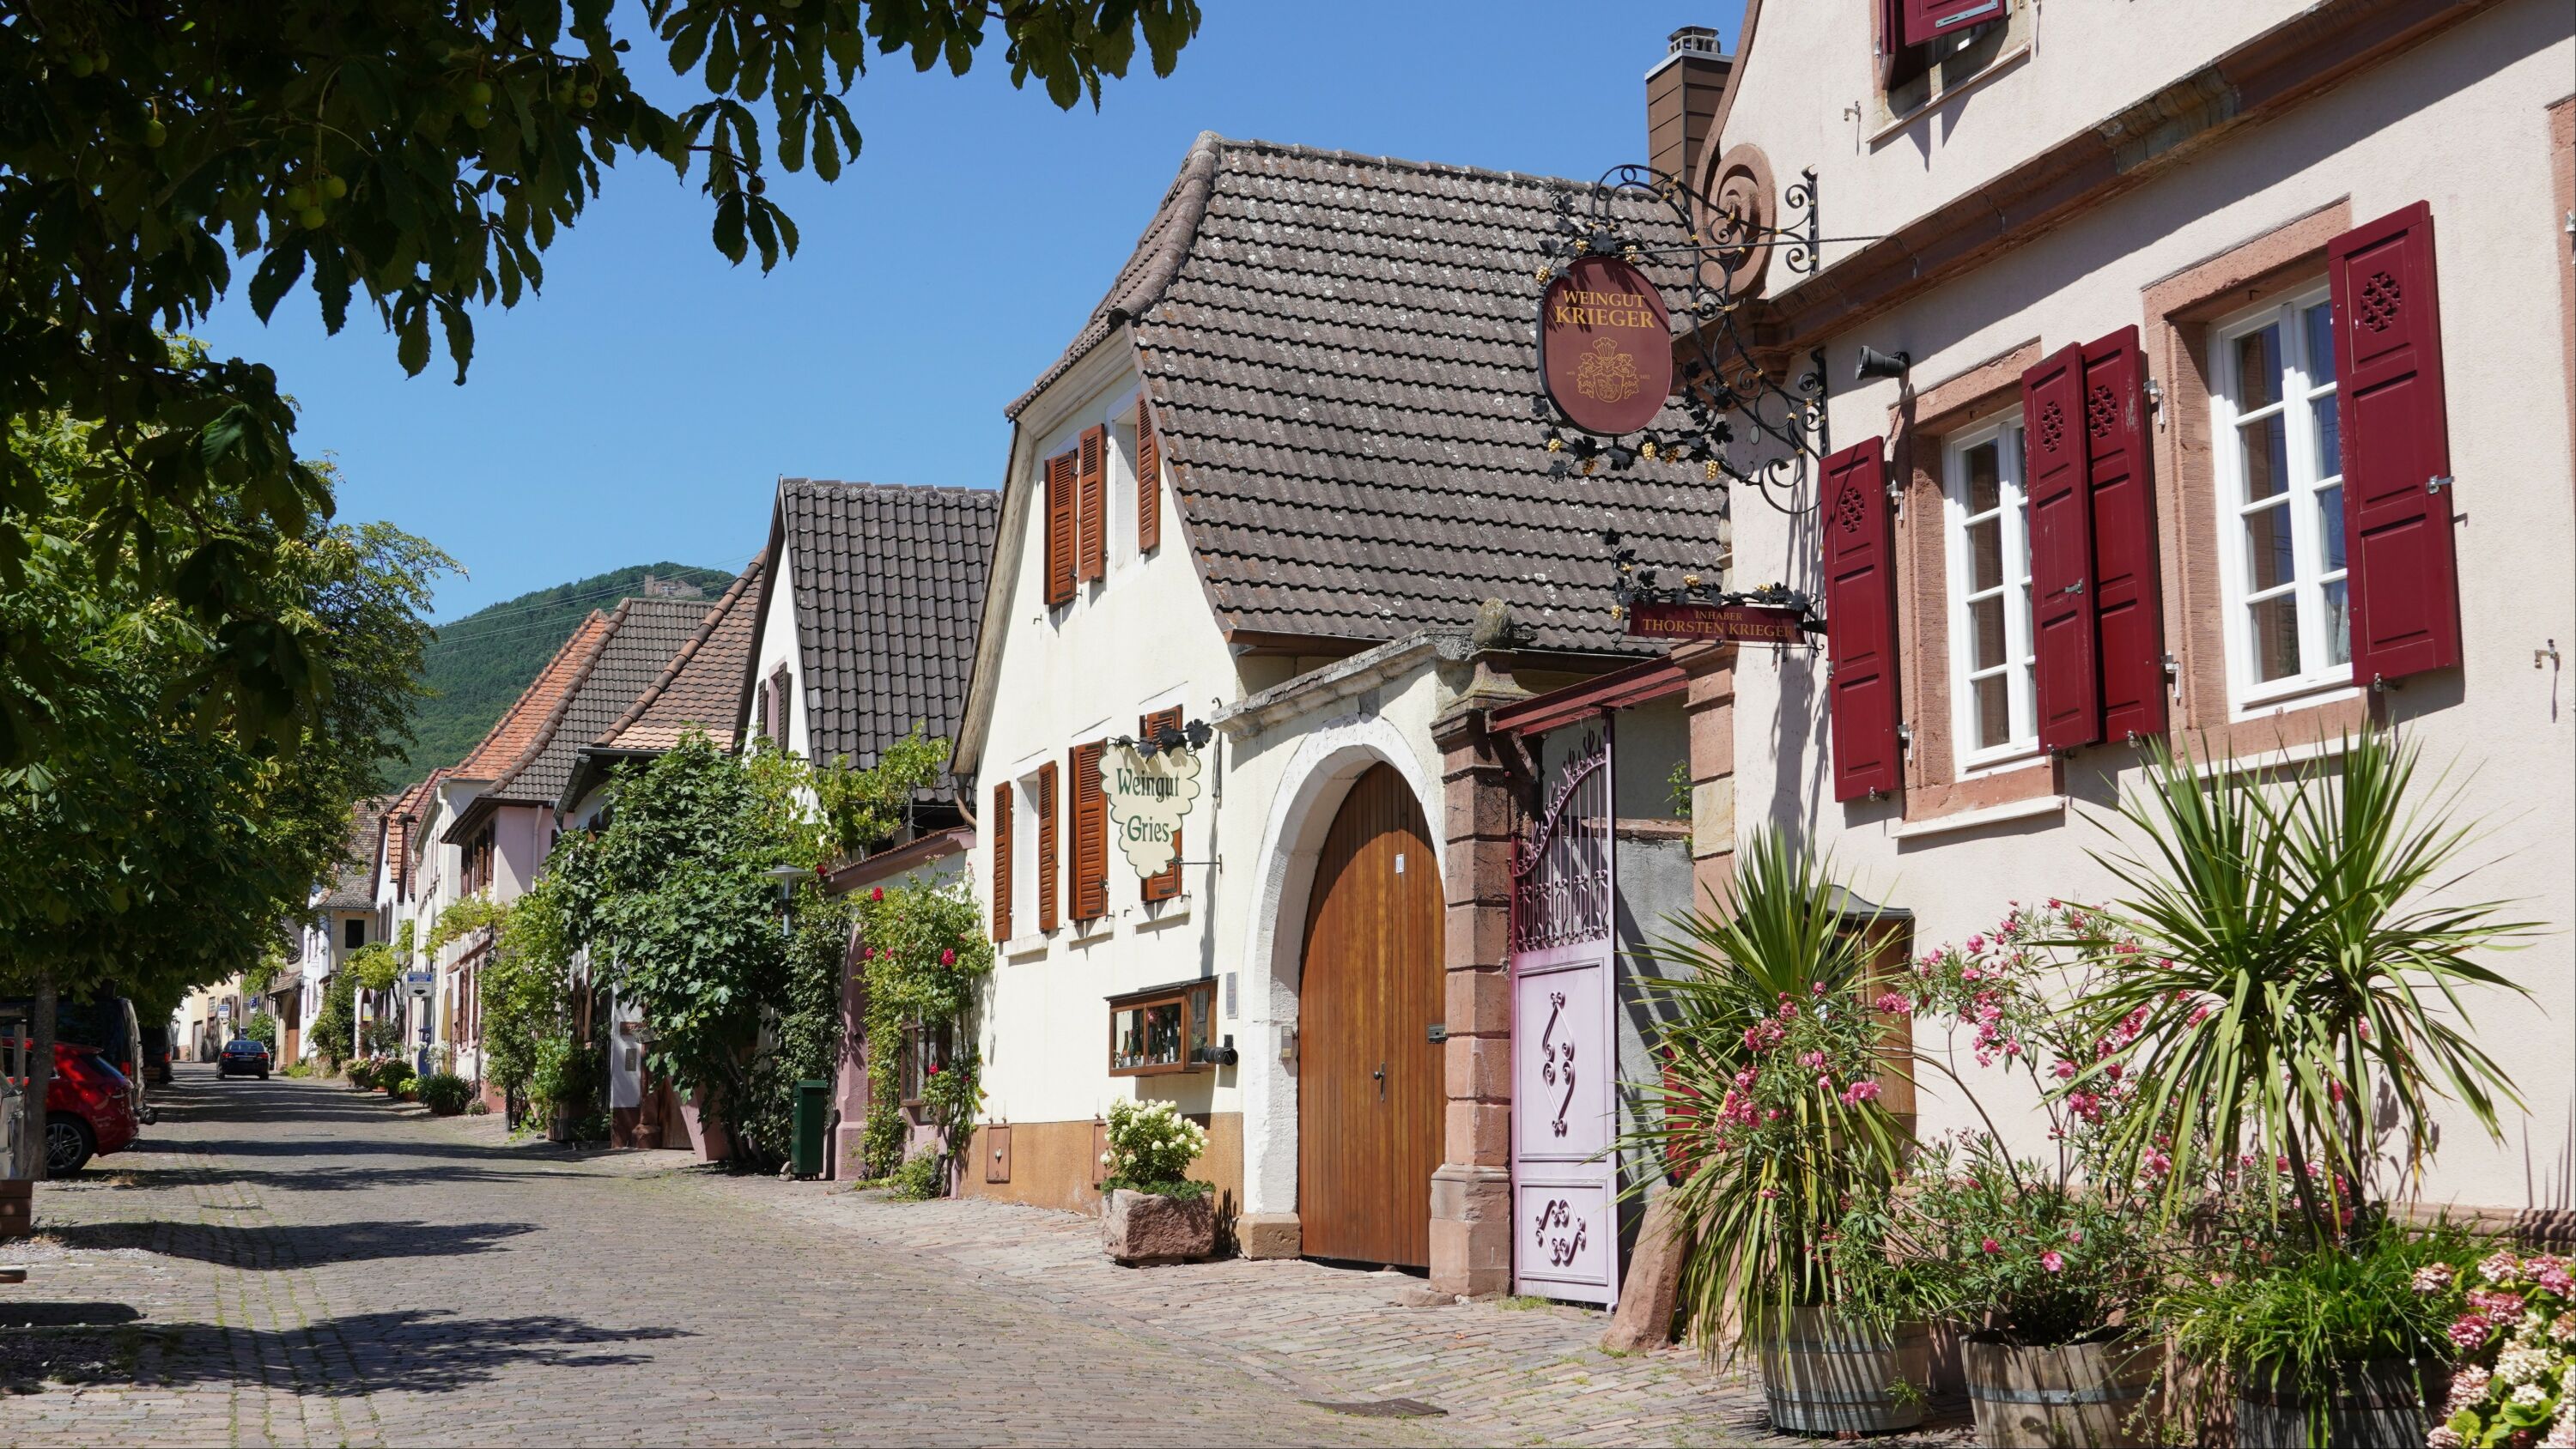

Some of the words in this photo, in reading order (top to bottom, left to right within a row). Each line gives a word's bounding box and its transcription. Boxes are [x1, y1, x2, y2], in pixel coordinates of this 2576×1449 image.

[1563, 290, 1645, 307] WEINGUT
[1555, 306, 1655, 328] KRIEGER
[1695, 610, 1743, 621] INHABER
[1643, 619, 1724, 634] THORSTEN
[1728, 624, 1794, 637] KRIEGER
[1116, 767, 1180, 803] Weingut
[1127, 815, 1170, 843] Gries
